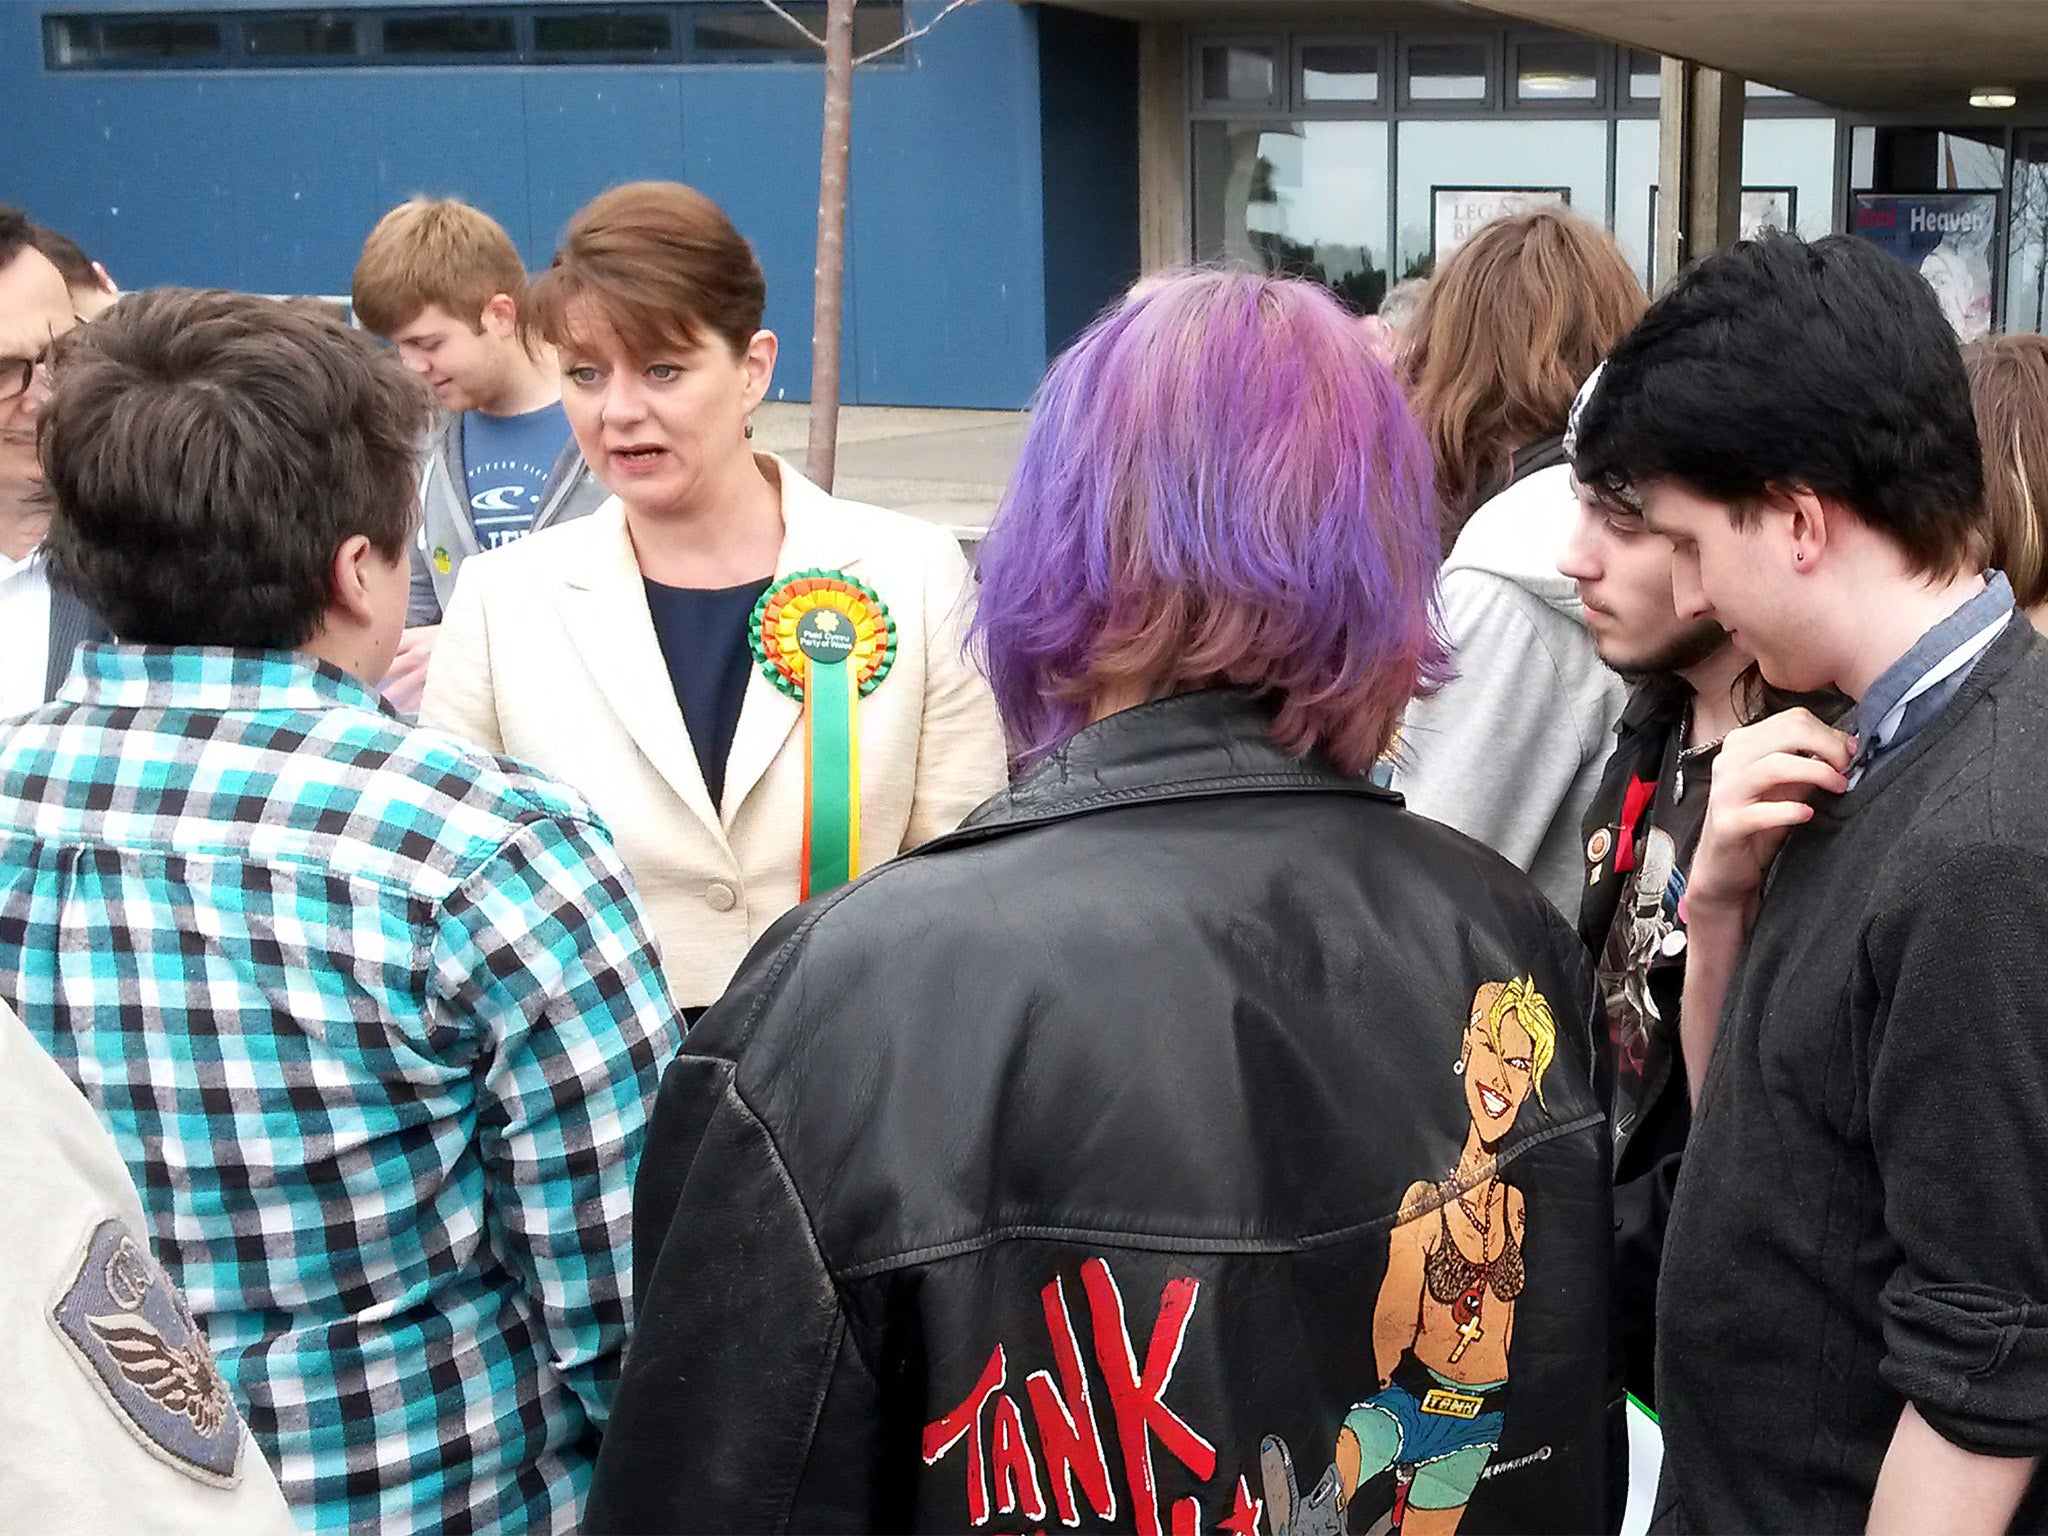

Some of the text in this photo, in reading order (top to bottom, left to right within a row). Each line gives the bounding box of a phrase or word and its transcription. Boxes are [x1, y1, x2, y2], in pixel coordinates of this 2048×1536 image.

[1910, 206, 1983, 232] Heaven
[799, 637, 820, 648] Party
[922, 1257, 1216, 1536] TANK
[1429, 1394, 1475, 1415] TANK
